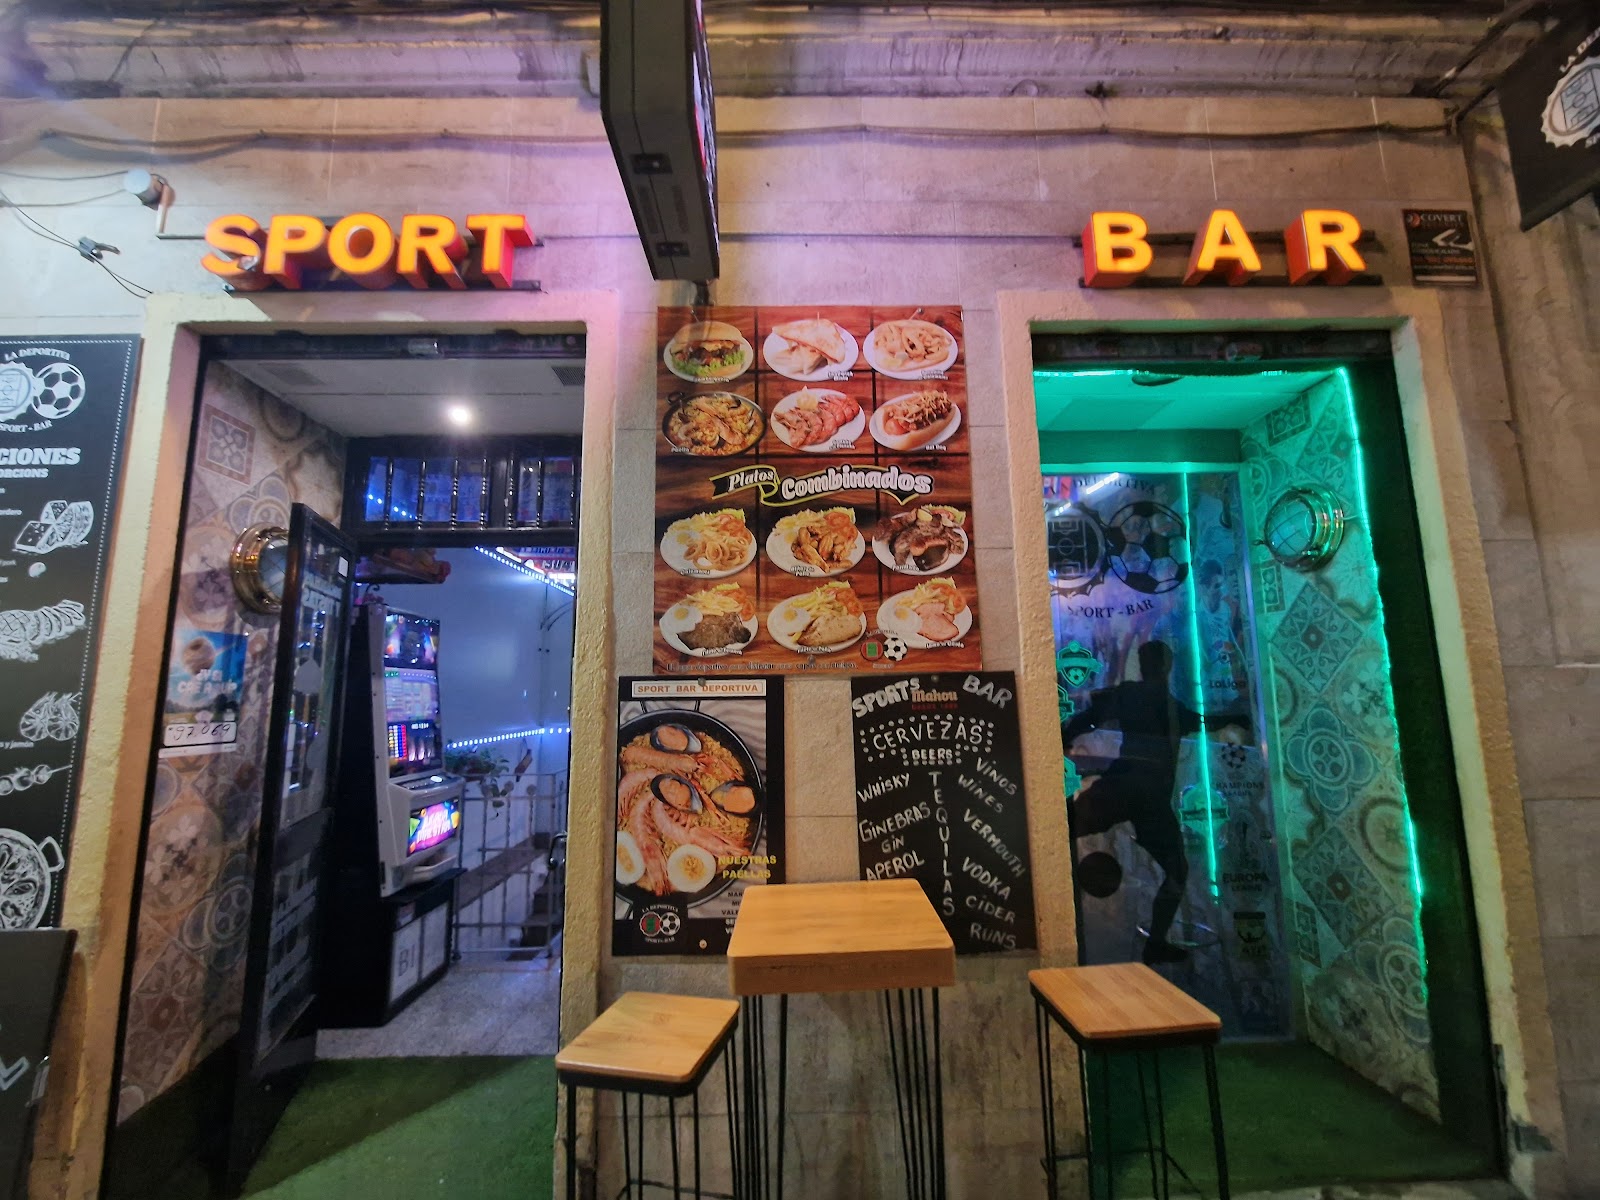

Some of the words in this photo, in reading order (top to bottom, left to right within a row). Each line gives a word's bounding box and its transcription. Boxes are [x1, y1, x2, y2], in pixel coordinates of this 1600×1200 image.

[201, 212, 529, 278] SPORT
[1088, 208, 1367, 275] BAR
[4, 351, 19, 361] LA
[727, 467, 775, 493] Platos
[780, 464, 934, 501] Combinados
[1126, 600, 1154, 616] BAR
[637, 685, 670, 693] SPORT
[676, 685, 697, 693] BAR
[702, 684, 758, 692] DEPORTIVA
[852, 677, 920, 718] SPORTS
[911, 688, 958, 702] Mahou
[963, 674, 1013, 710] BAR
[873, 720, 983, 751] CERVEZAS
[911, 748, 954, 761] BEERS
[928, 770, 956, 917] TEQUILAS
[963, 808, 1026, 877] VERMOUTH
[717, 855, 778, 866] NUESTRAS
[722, 869, 772, 880] PAELLAS
[865, 850, 926, 882] APEROL
[961, 856, 1012, 901] VODKA
